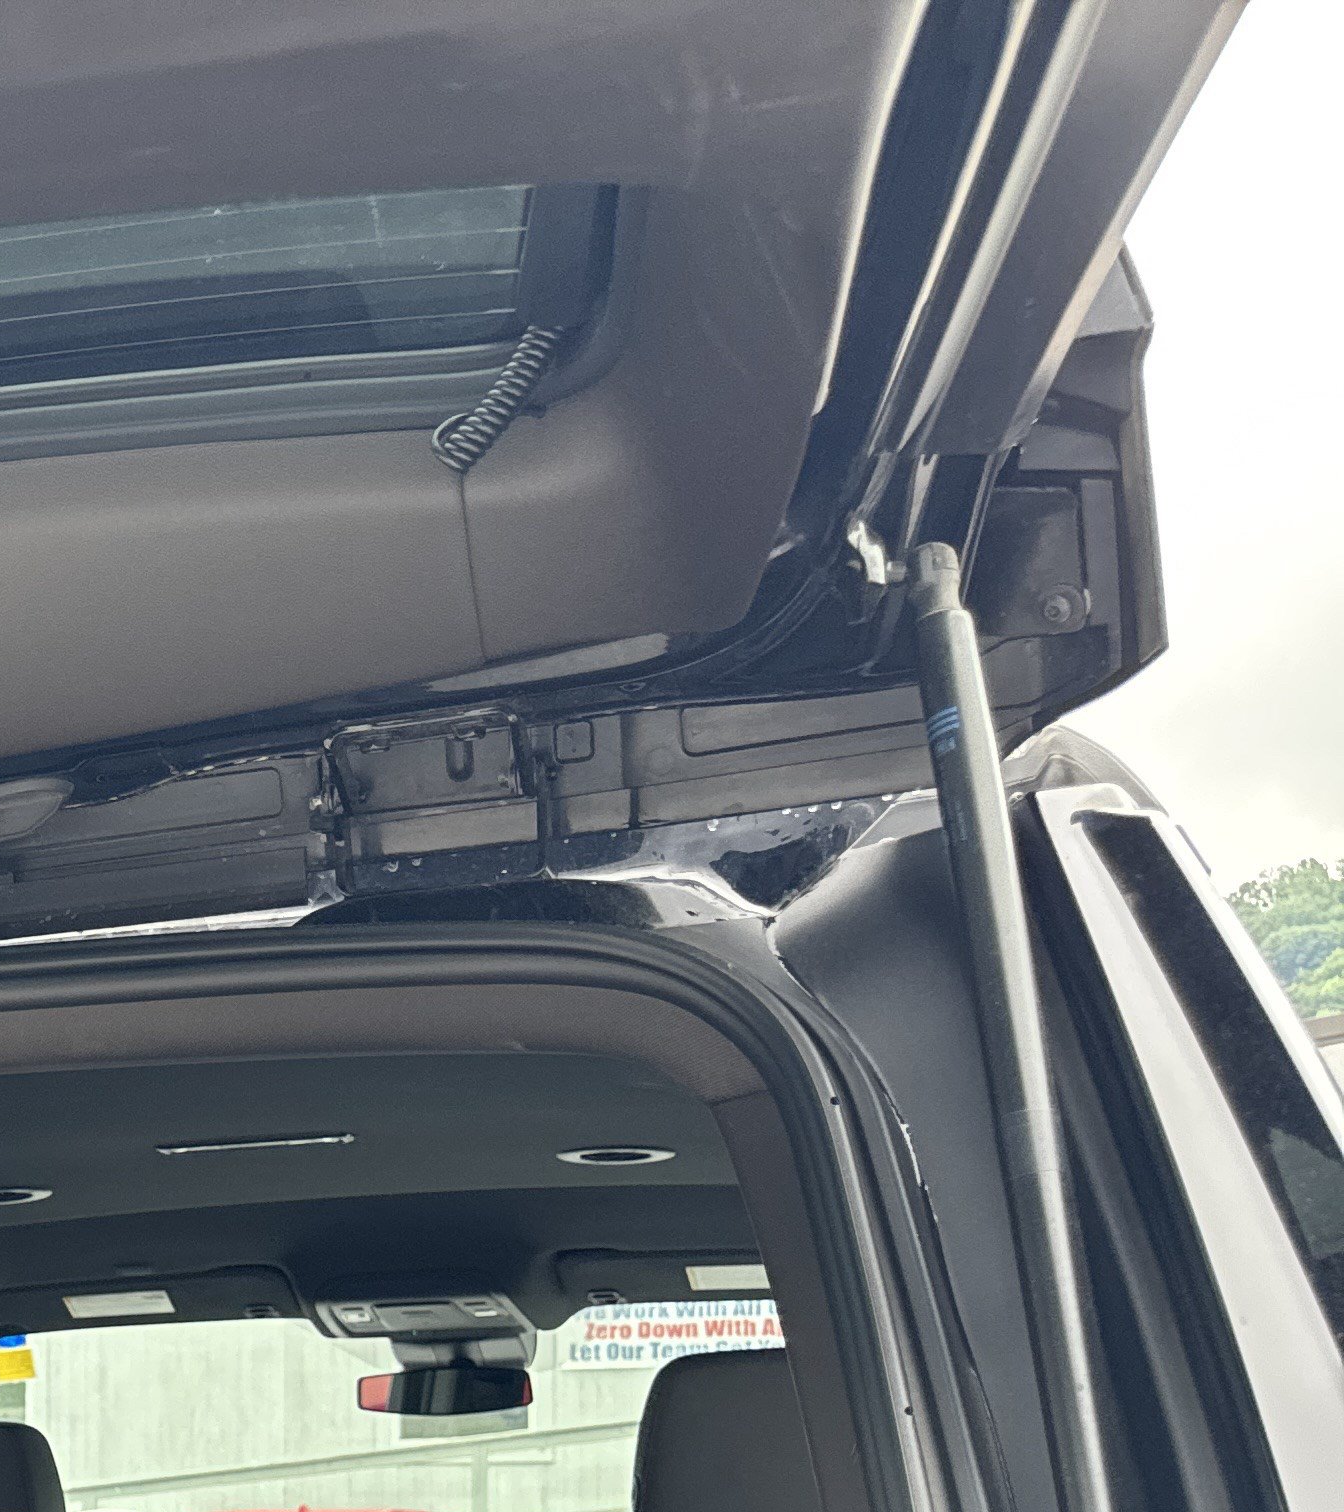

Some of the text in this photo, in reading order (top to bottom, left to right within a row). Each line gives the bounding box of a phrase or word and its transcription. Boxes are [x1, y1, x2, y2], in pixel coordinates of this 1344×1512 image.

[584, 1321, 631, 1340] Zero
[638, 1320, 698, 1339] Down
[704, 1319, 756, 1338] With
[569, 1342, 601, 1362] Let
[607, 1342, 644, 1361] Our
